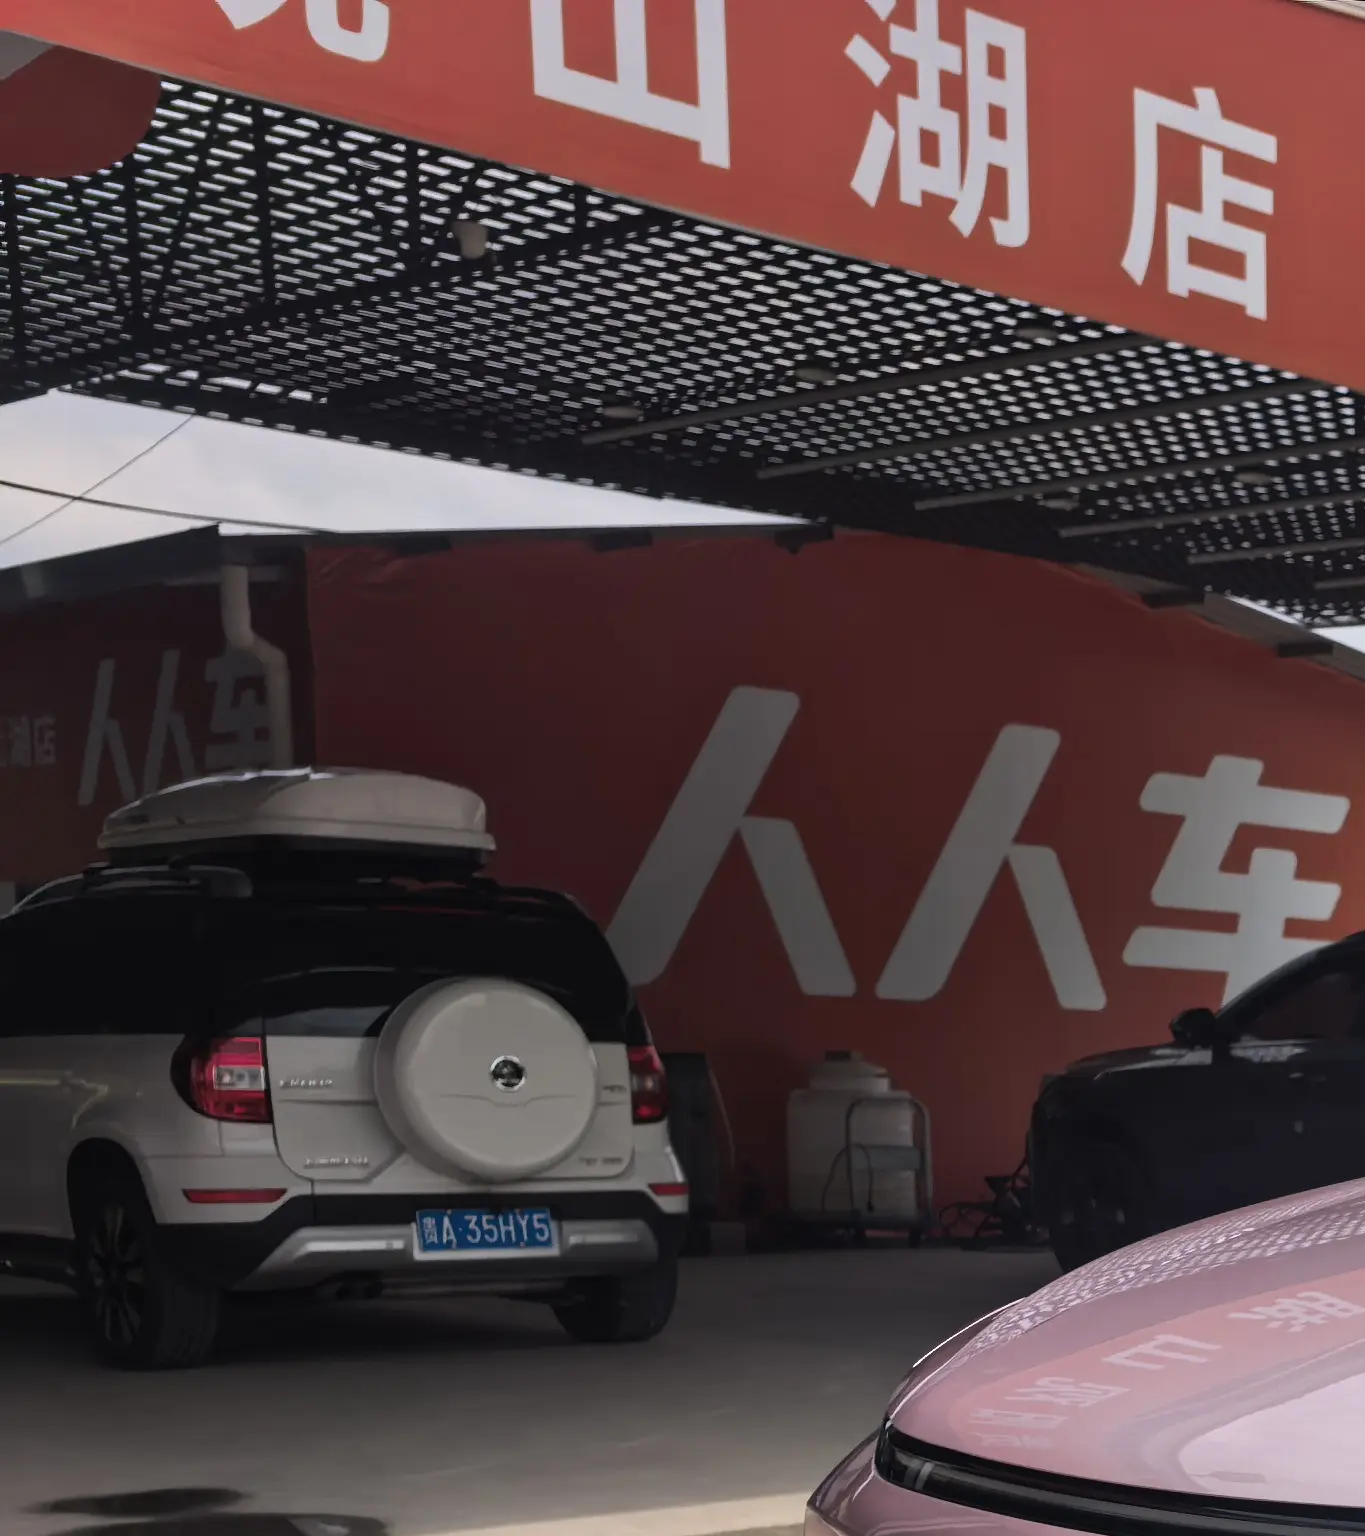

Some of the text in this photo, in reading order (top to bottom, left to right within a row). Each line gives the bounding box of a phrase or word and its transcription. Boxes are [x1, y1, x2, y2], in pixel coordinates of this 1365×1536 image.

[222, 0, 1277, 321] 山湖店
[604, 685, 1351, 1011] 人人车
